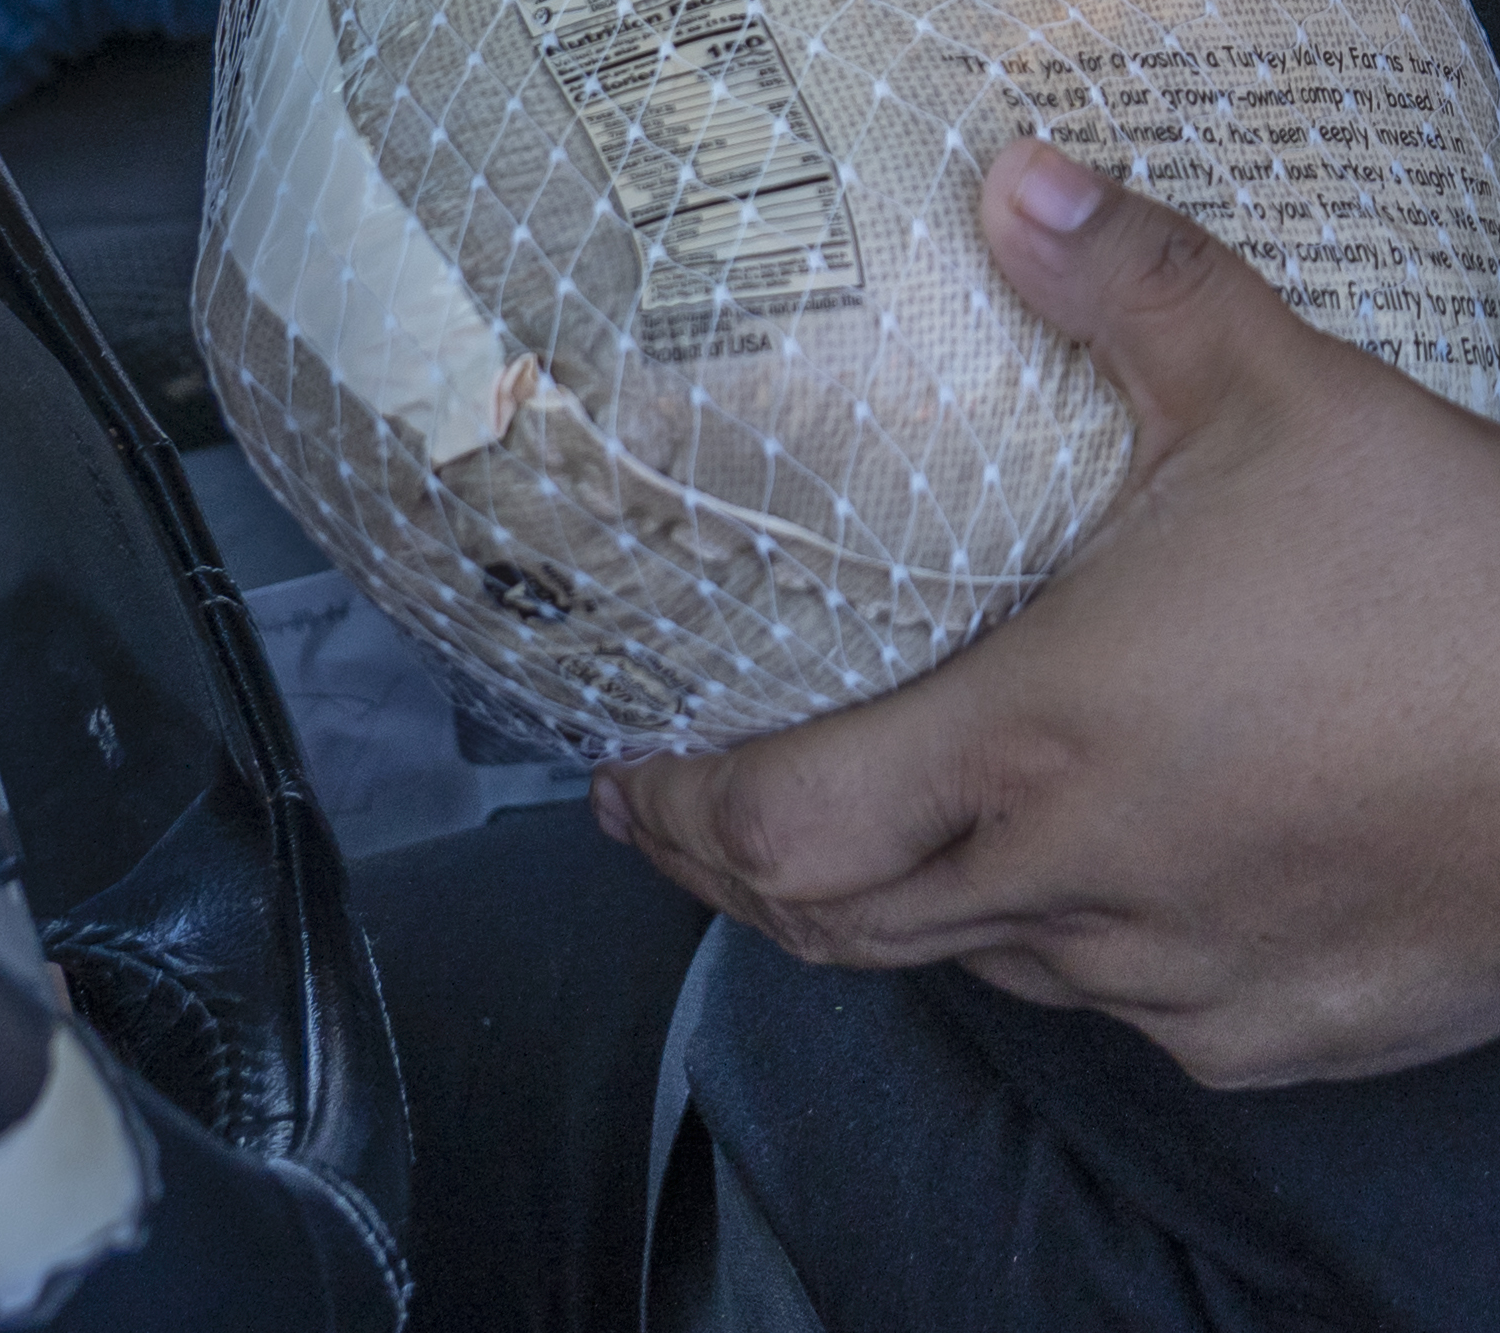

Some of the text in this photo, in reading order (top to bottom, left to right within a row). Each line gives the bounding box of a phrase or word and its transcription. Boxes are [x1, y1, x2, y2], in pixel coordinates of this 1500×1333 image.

[546, 13, 662, 55] utrition
[1040, 56, 1074, 80] you
[1079, 50, 1104, 72] for
[1206, 50, 1220, 68] a
[1221, 45, 1286, 75] Turkey
[1292, 44, 1344, 74] Valley
[1002, 87, 1059, 108] Since
[1120, 88, 1152, 106] our
[1300, 86, 1382, 114] compny,
[1384, 84, 1435, 111] based
[1436, 91, 1455, 118] in
[1017, 119, 1108, 147] Mrshall,
[1228, 121, 1264, 145] has
[1267, 121, 1308, 145] been
[1310, 117, 1370, 151] eeply
[1373, 121, 1447, 152] invested
[1448, 129, 1467, 155] in
[1321, 157, 1385, 190] turkey
[1430, 249, 1452, 270] we
[1426, 285, 1447, 316] to
[1452, 288, 1499, 326] proide
[729, 333, 774, 355] USA
